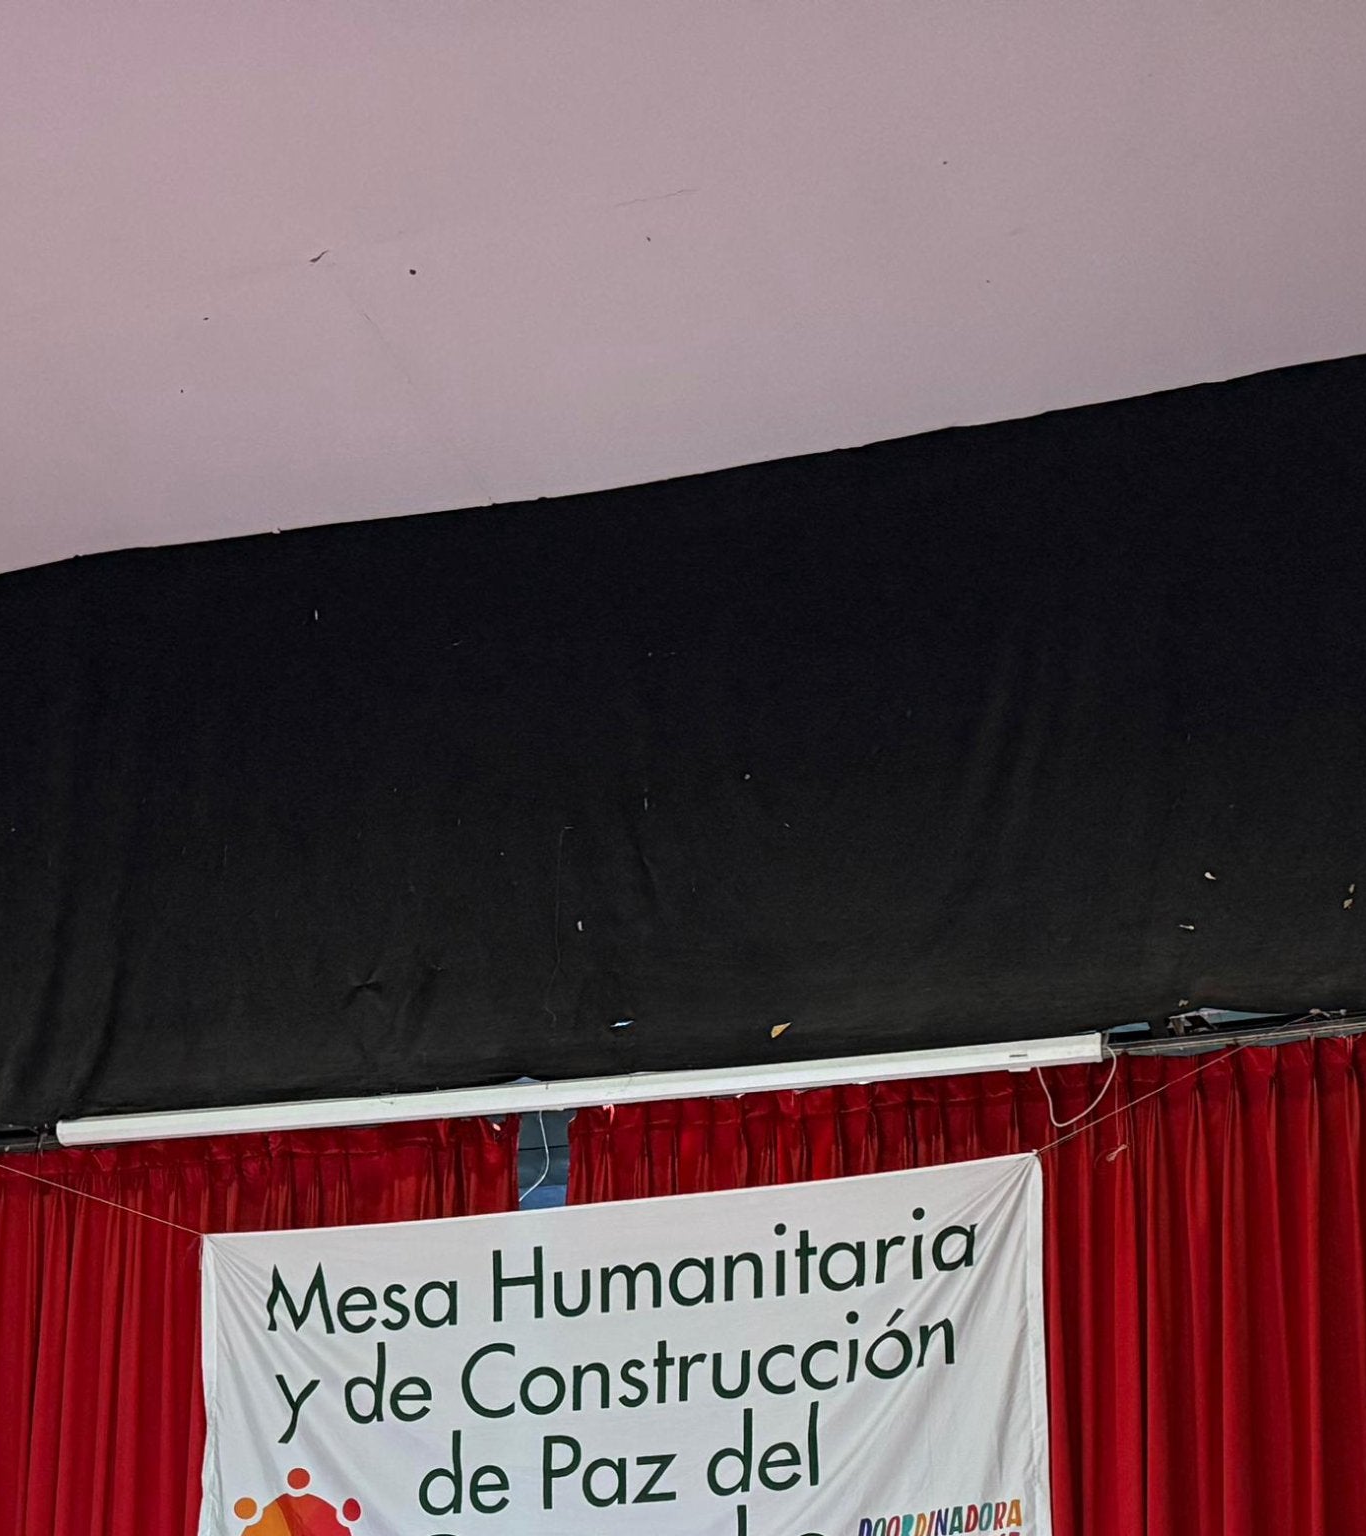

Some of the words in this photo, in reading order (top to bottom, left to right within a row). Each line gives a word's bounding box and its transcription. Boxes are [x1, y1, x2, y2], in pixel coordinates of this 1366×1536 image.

[268, 1263, 458, 1337] Mesa
[492, 1207, 978, 1322] Humanitaria
[276, 1372, 320, 1444] y
[345, 1342, 432, 1425] de
[462, 1308, 956, 1419] Construcción
[418, 1430, 509, 1516] de
[543, 1435, 677, 1511] Paz
[707, 1403, 820, 1497] del
